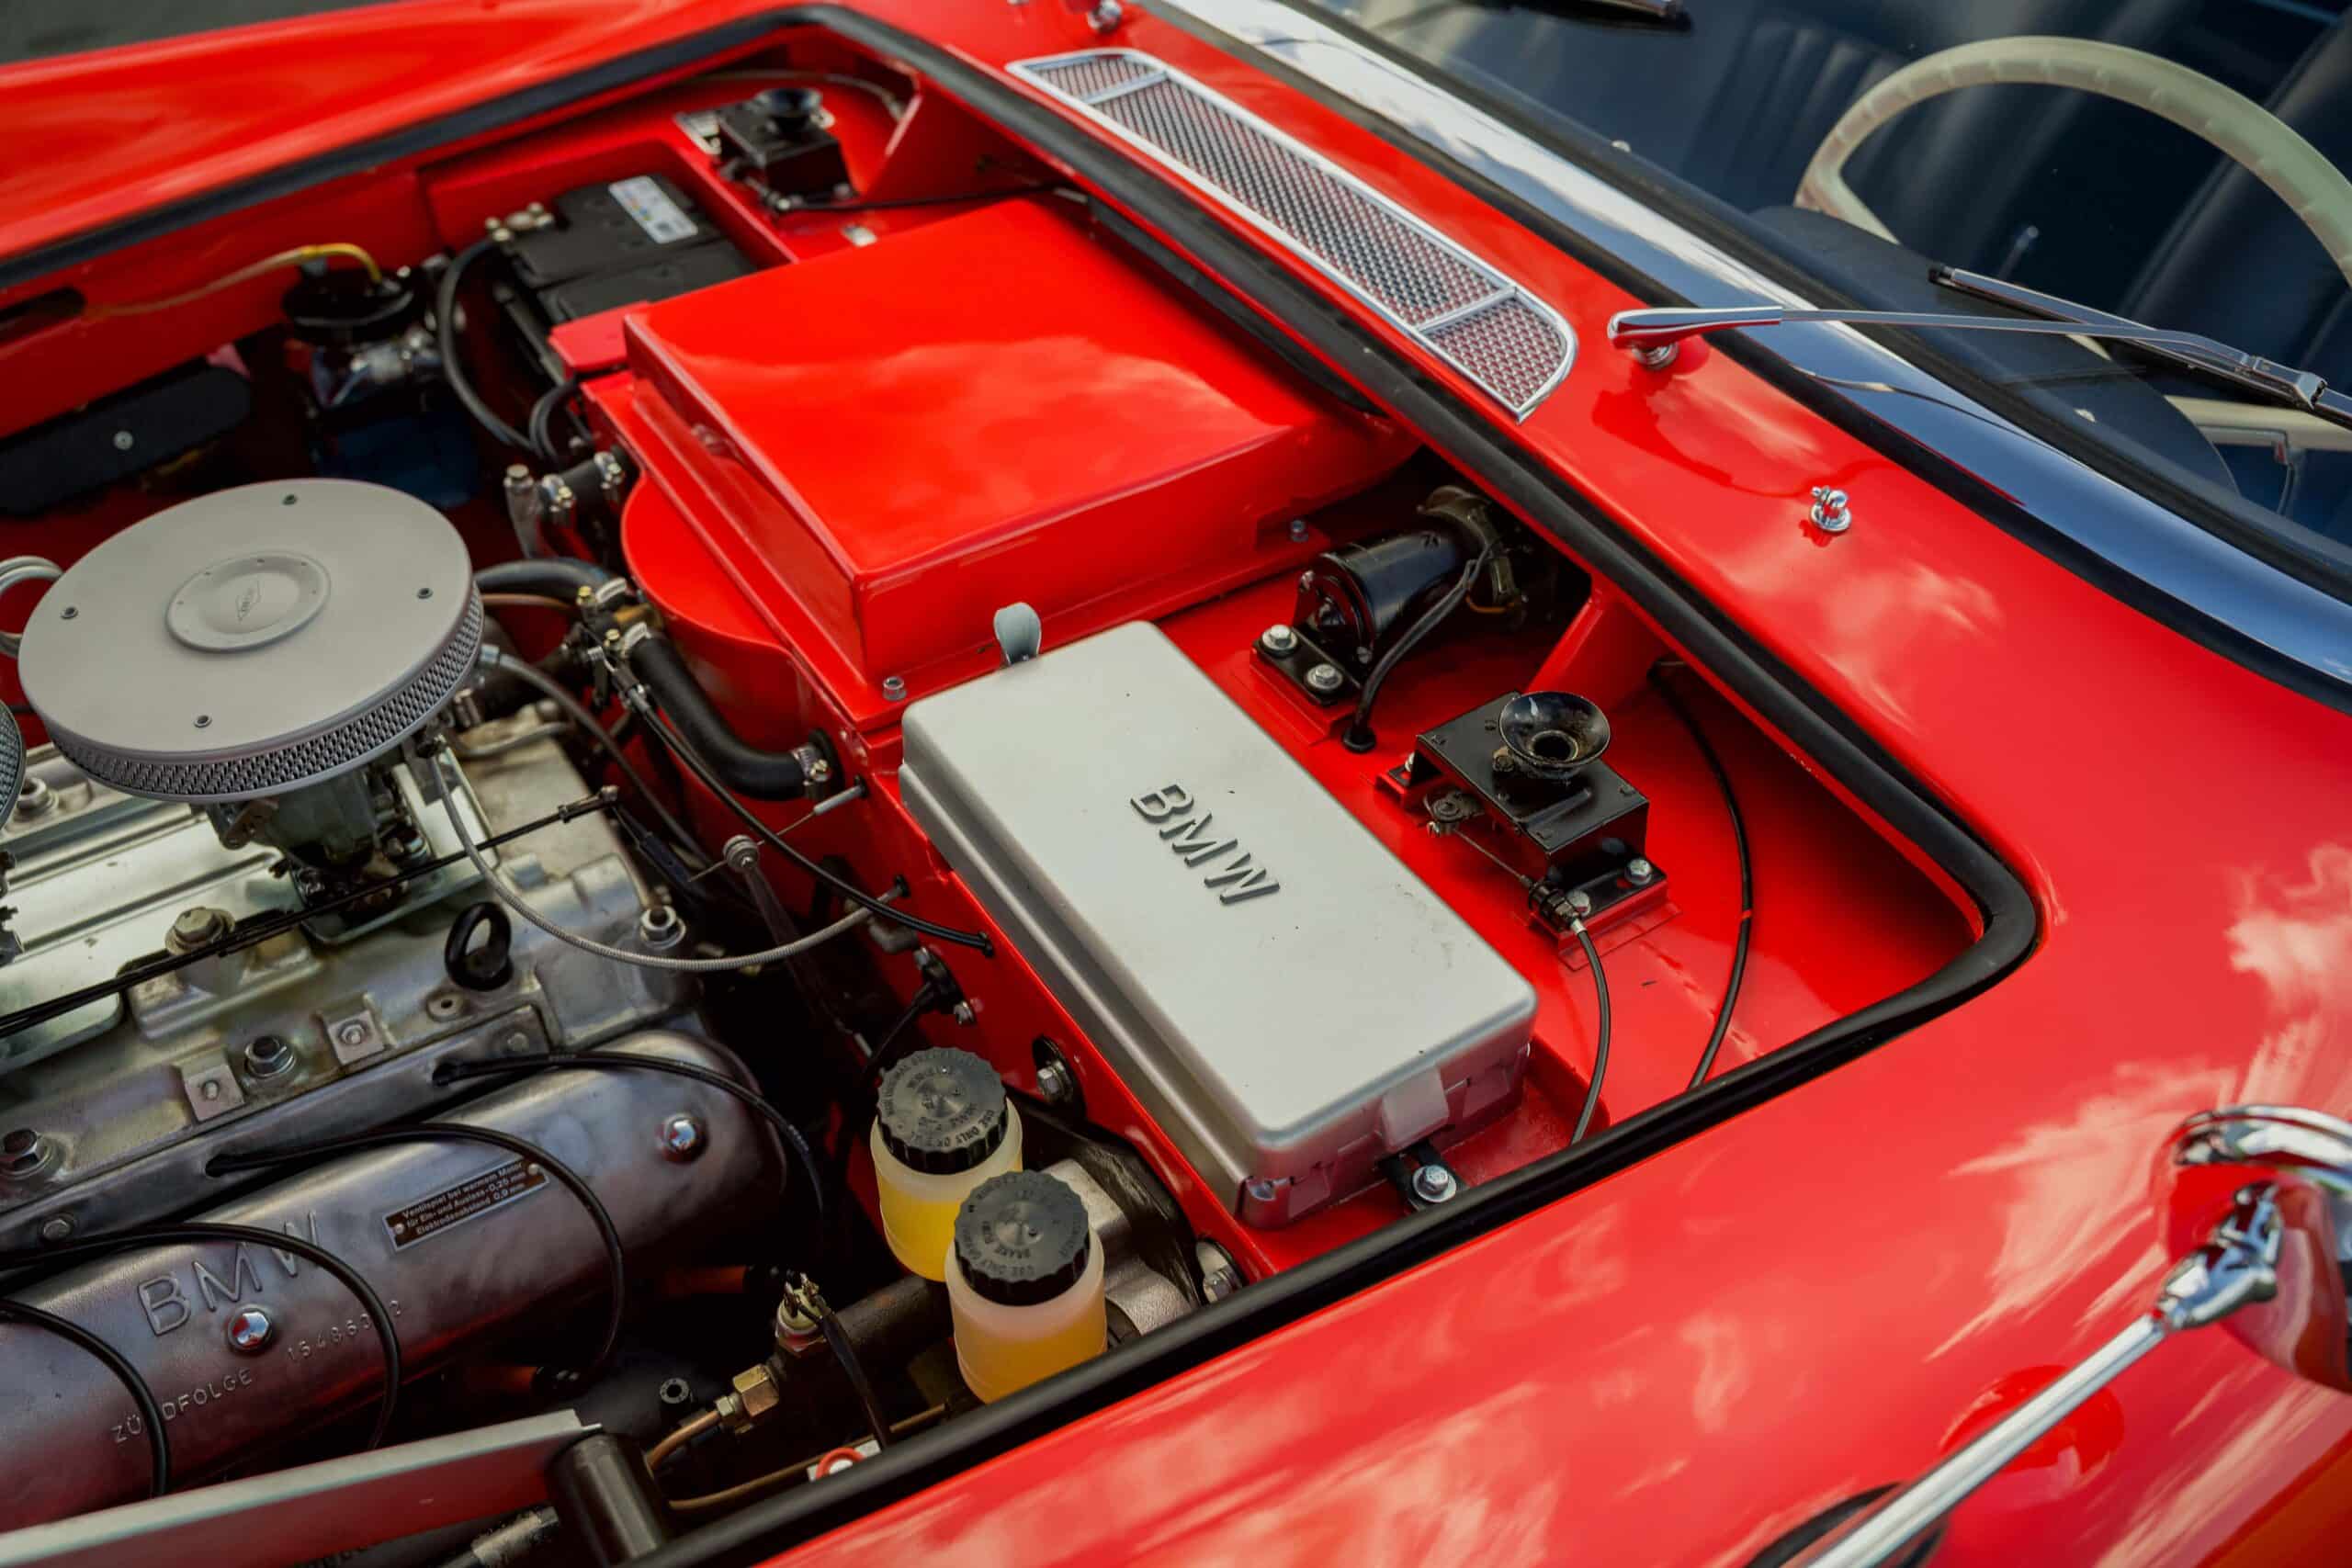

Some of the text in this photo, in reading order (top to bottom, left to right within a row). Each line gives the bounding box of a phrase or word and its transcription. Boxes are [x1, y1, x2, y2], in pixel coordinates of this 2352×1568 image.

[1130, 784, 1281, 906] BMW
[138, 1211, 319, 1336] BMW
[113, 1300, 401, 1444] ZÜDFOLGE 1548632
